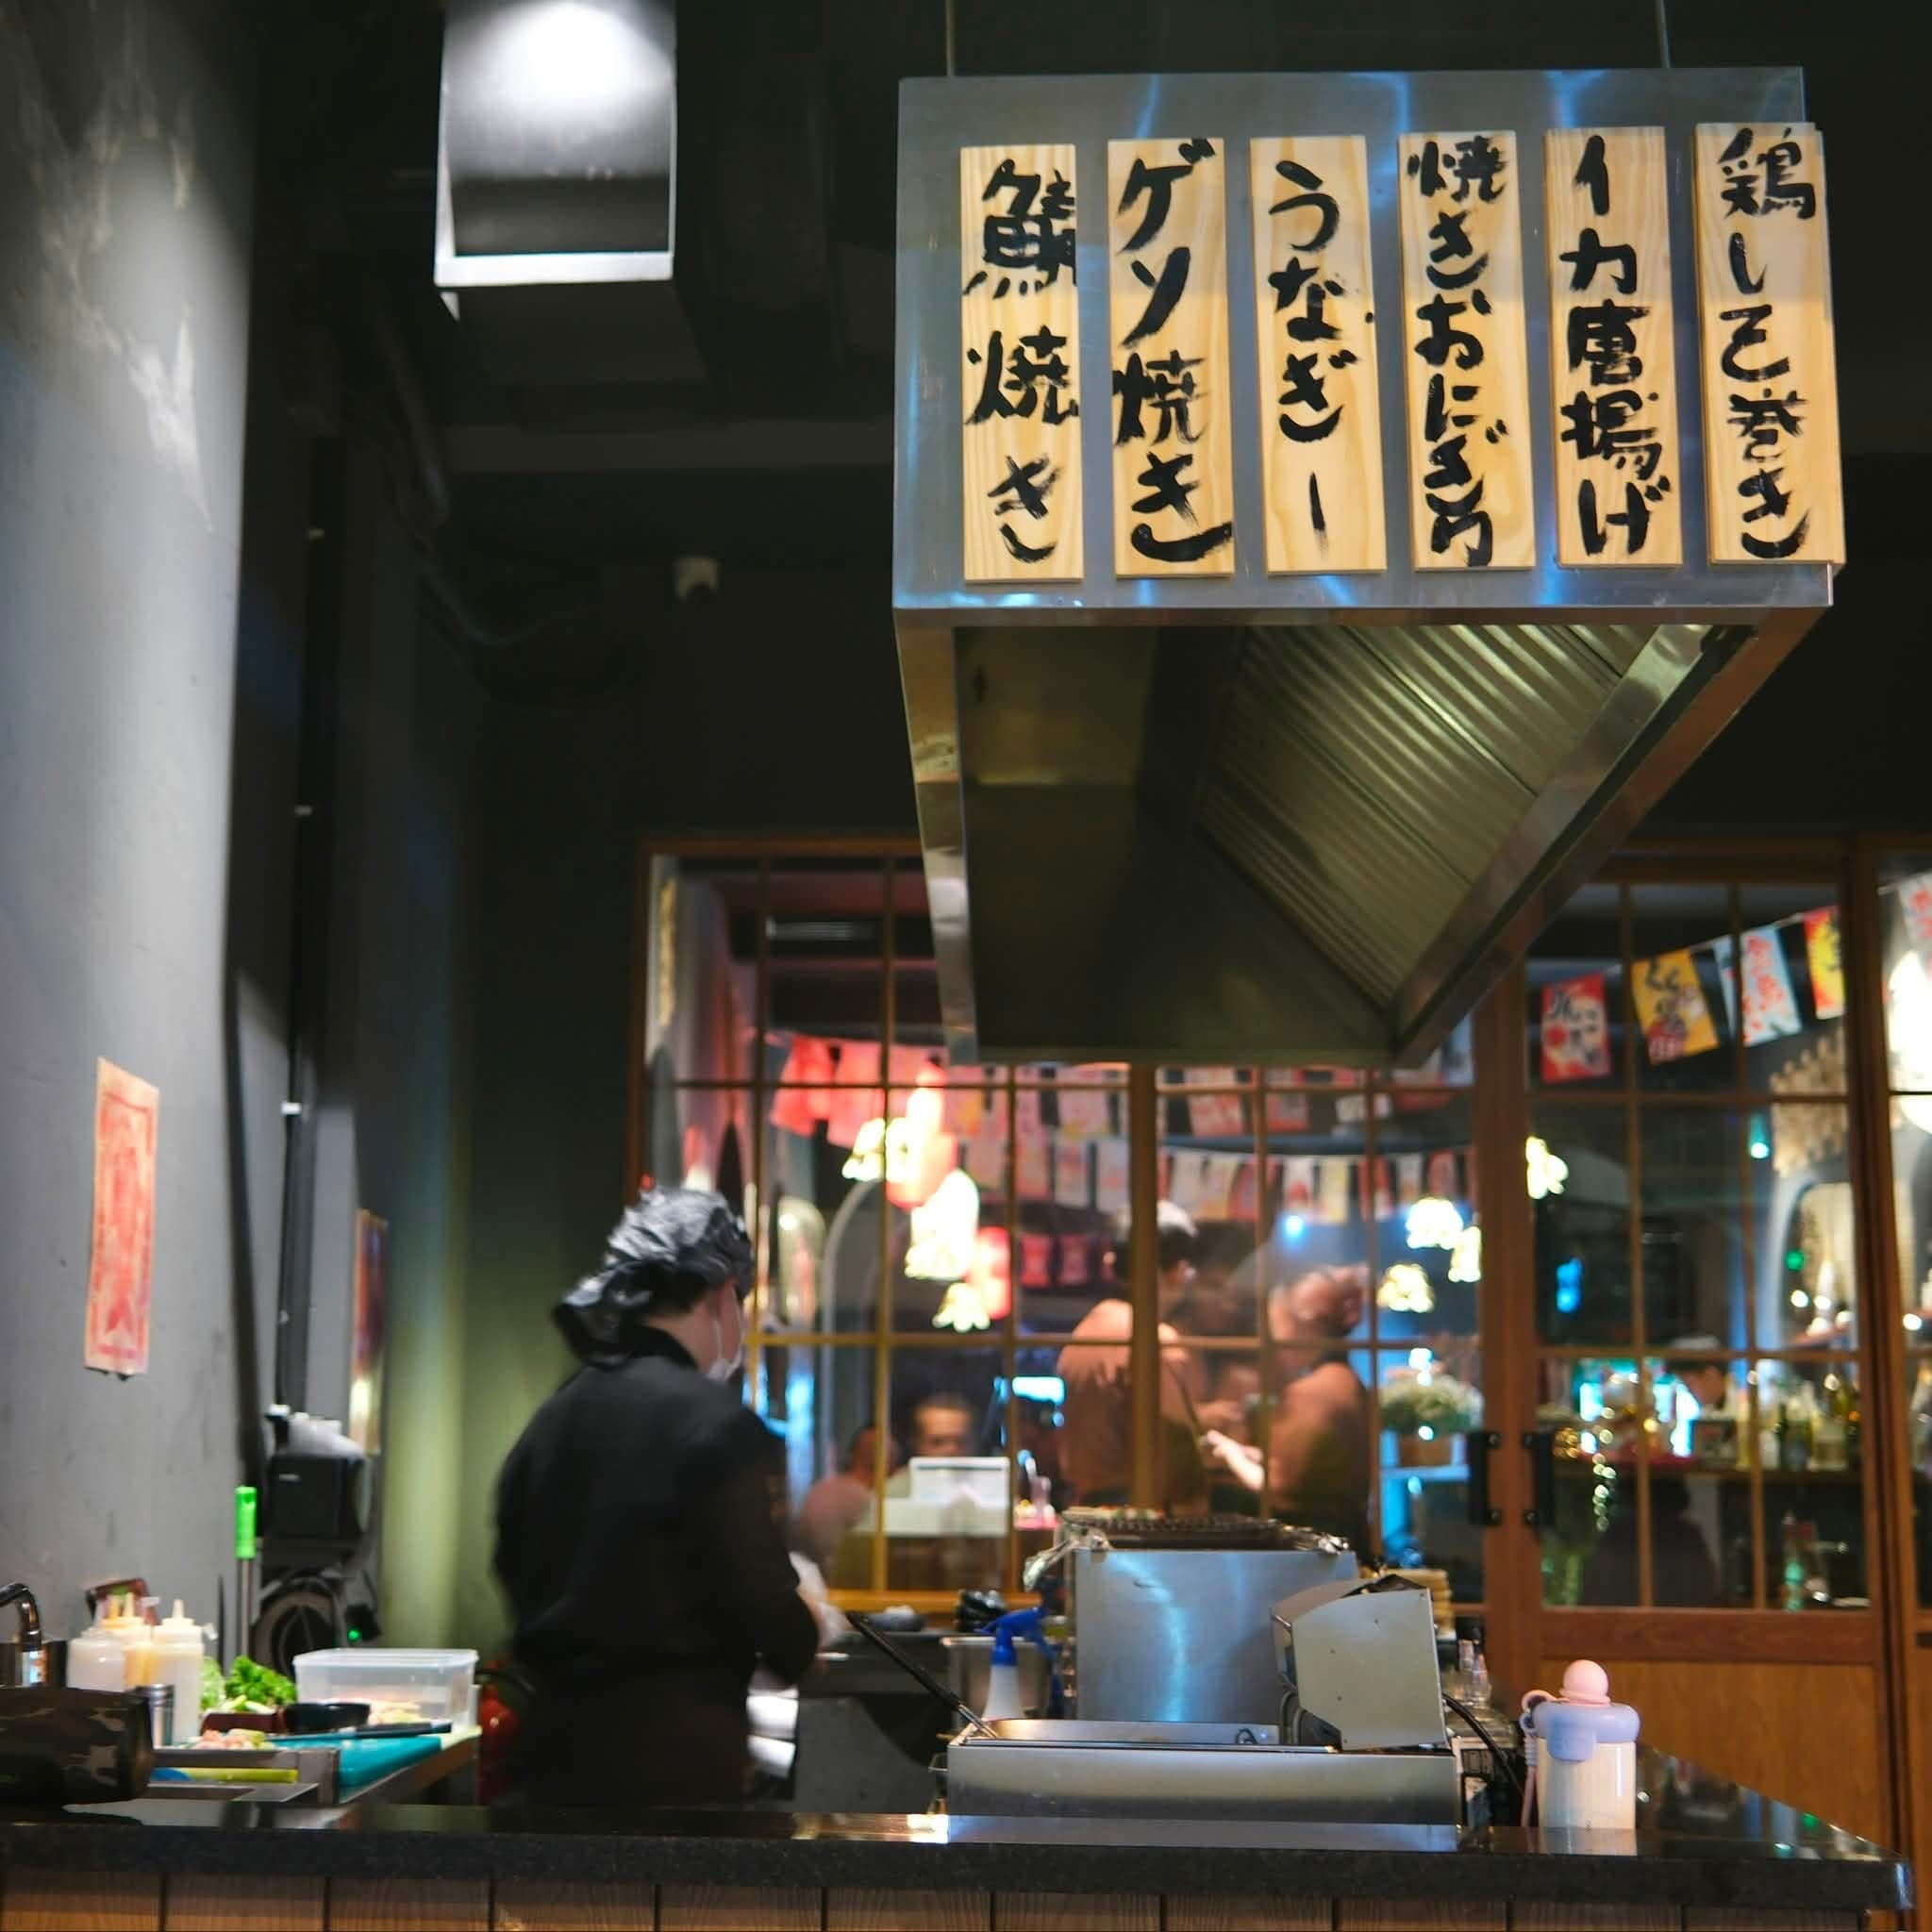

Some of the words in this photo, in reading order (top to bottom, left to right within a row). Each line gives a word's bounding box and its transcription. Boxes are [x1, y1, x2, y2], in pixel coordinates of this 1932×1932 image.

[963, 158, 1078, 563] 鯖焼き
[1112, 138, 1233, 561] ゲソ焼き
[1407, 136, 1510, 567] 焼きおにぎり
[1560, 135, 1671, 557] イカ唐揚げ
[1717, 127, 1817, 559] 鶏しそ巻き
